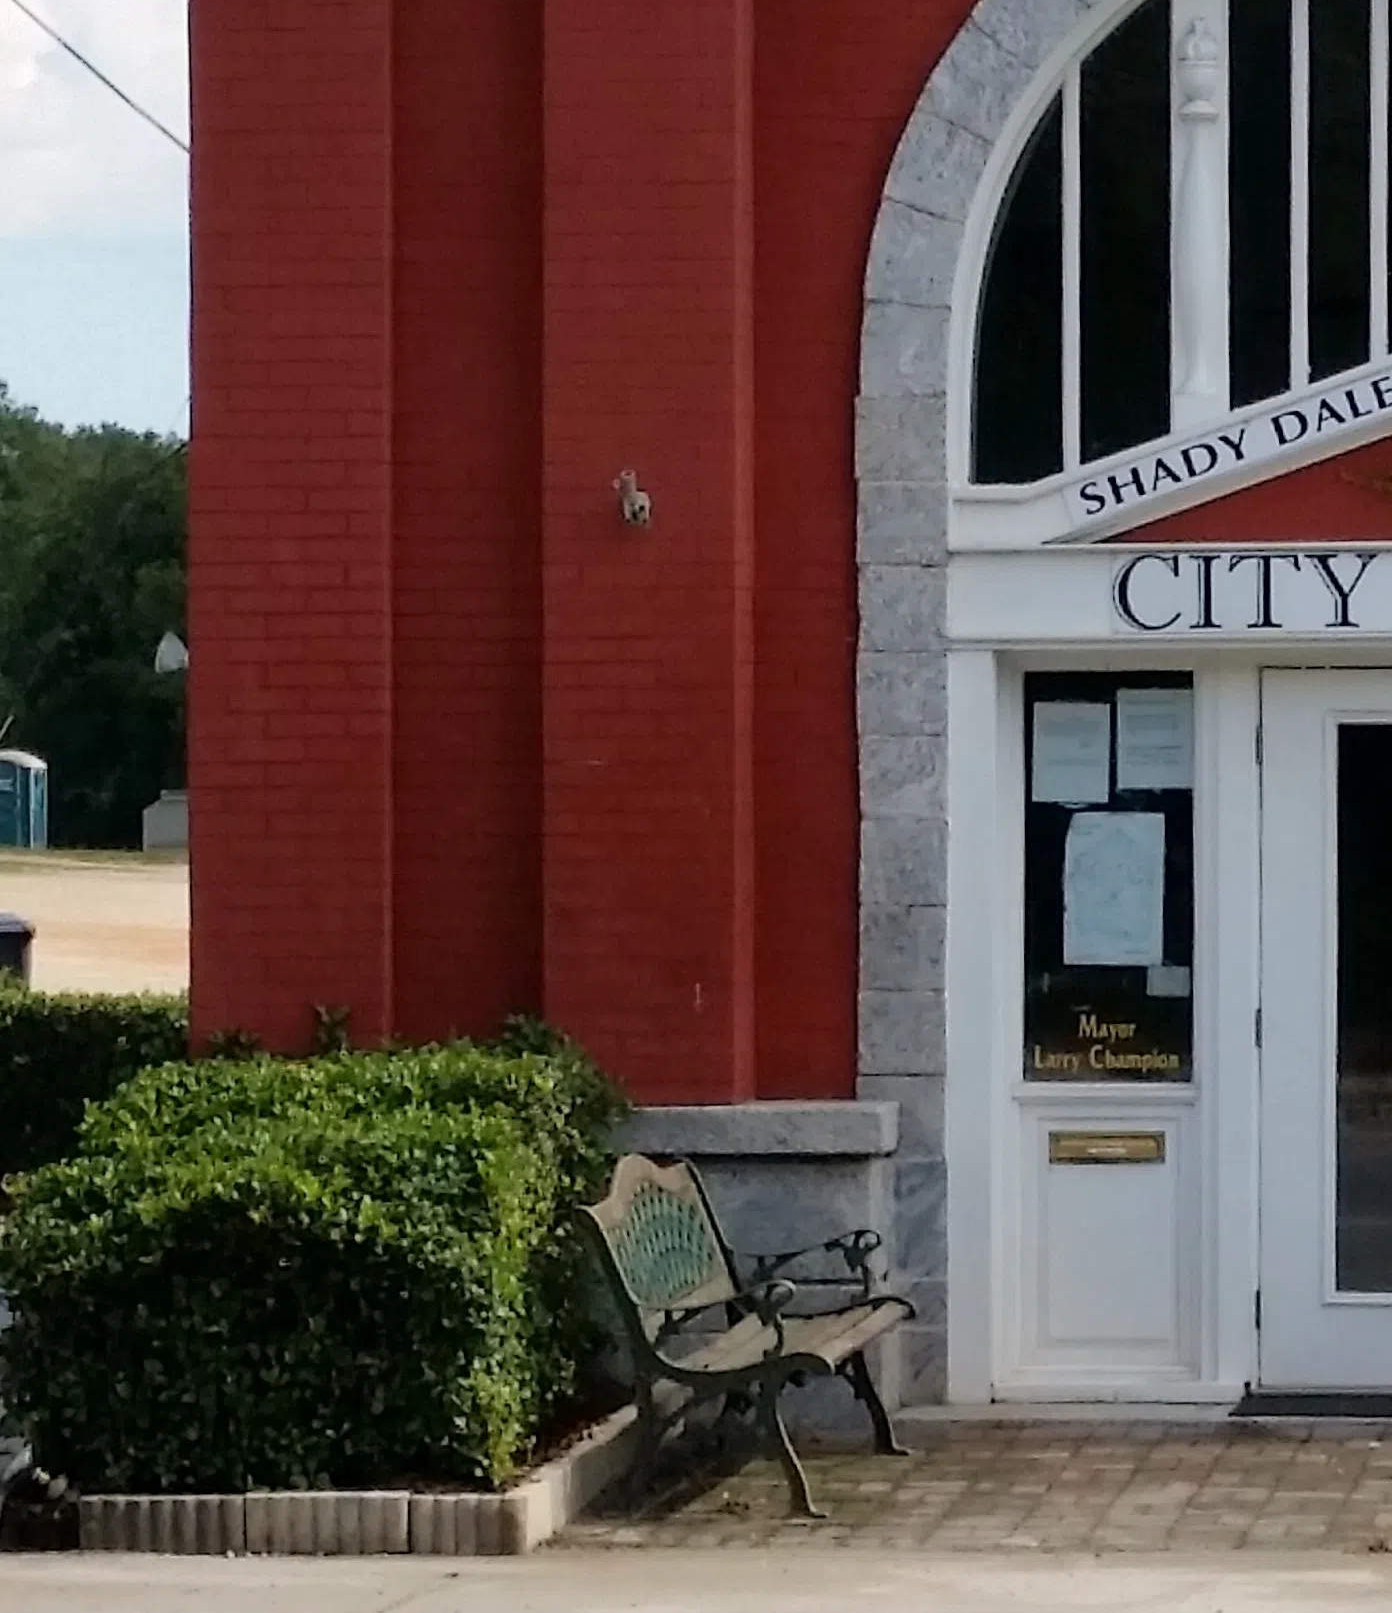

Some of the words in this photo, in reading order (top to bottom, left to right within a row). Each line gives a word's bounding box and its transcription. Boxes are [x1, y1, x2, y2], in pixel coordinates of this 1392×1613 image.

[1079, 428, 1248, 515] SHADY
[1112, 553, 1378, 631] CITY
[1078, 1013, 1137, 1043] Mayor
[1034, 1044, 1080, 1073] Larry
[1089, 1043, 1180, 1073] Champion
